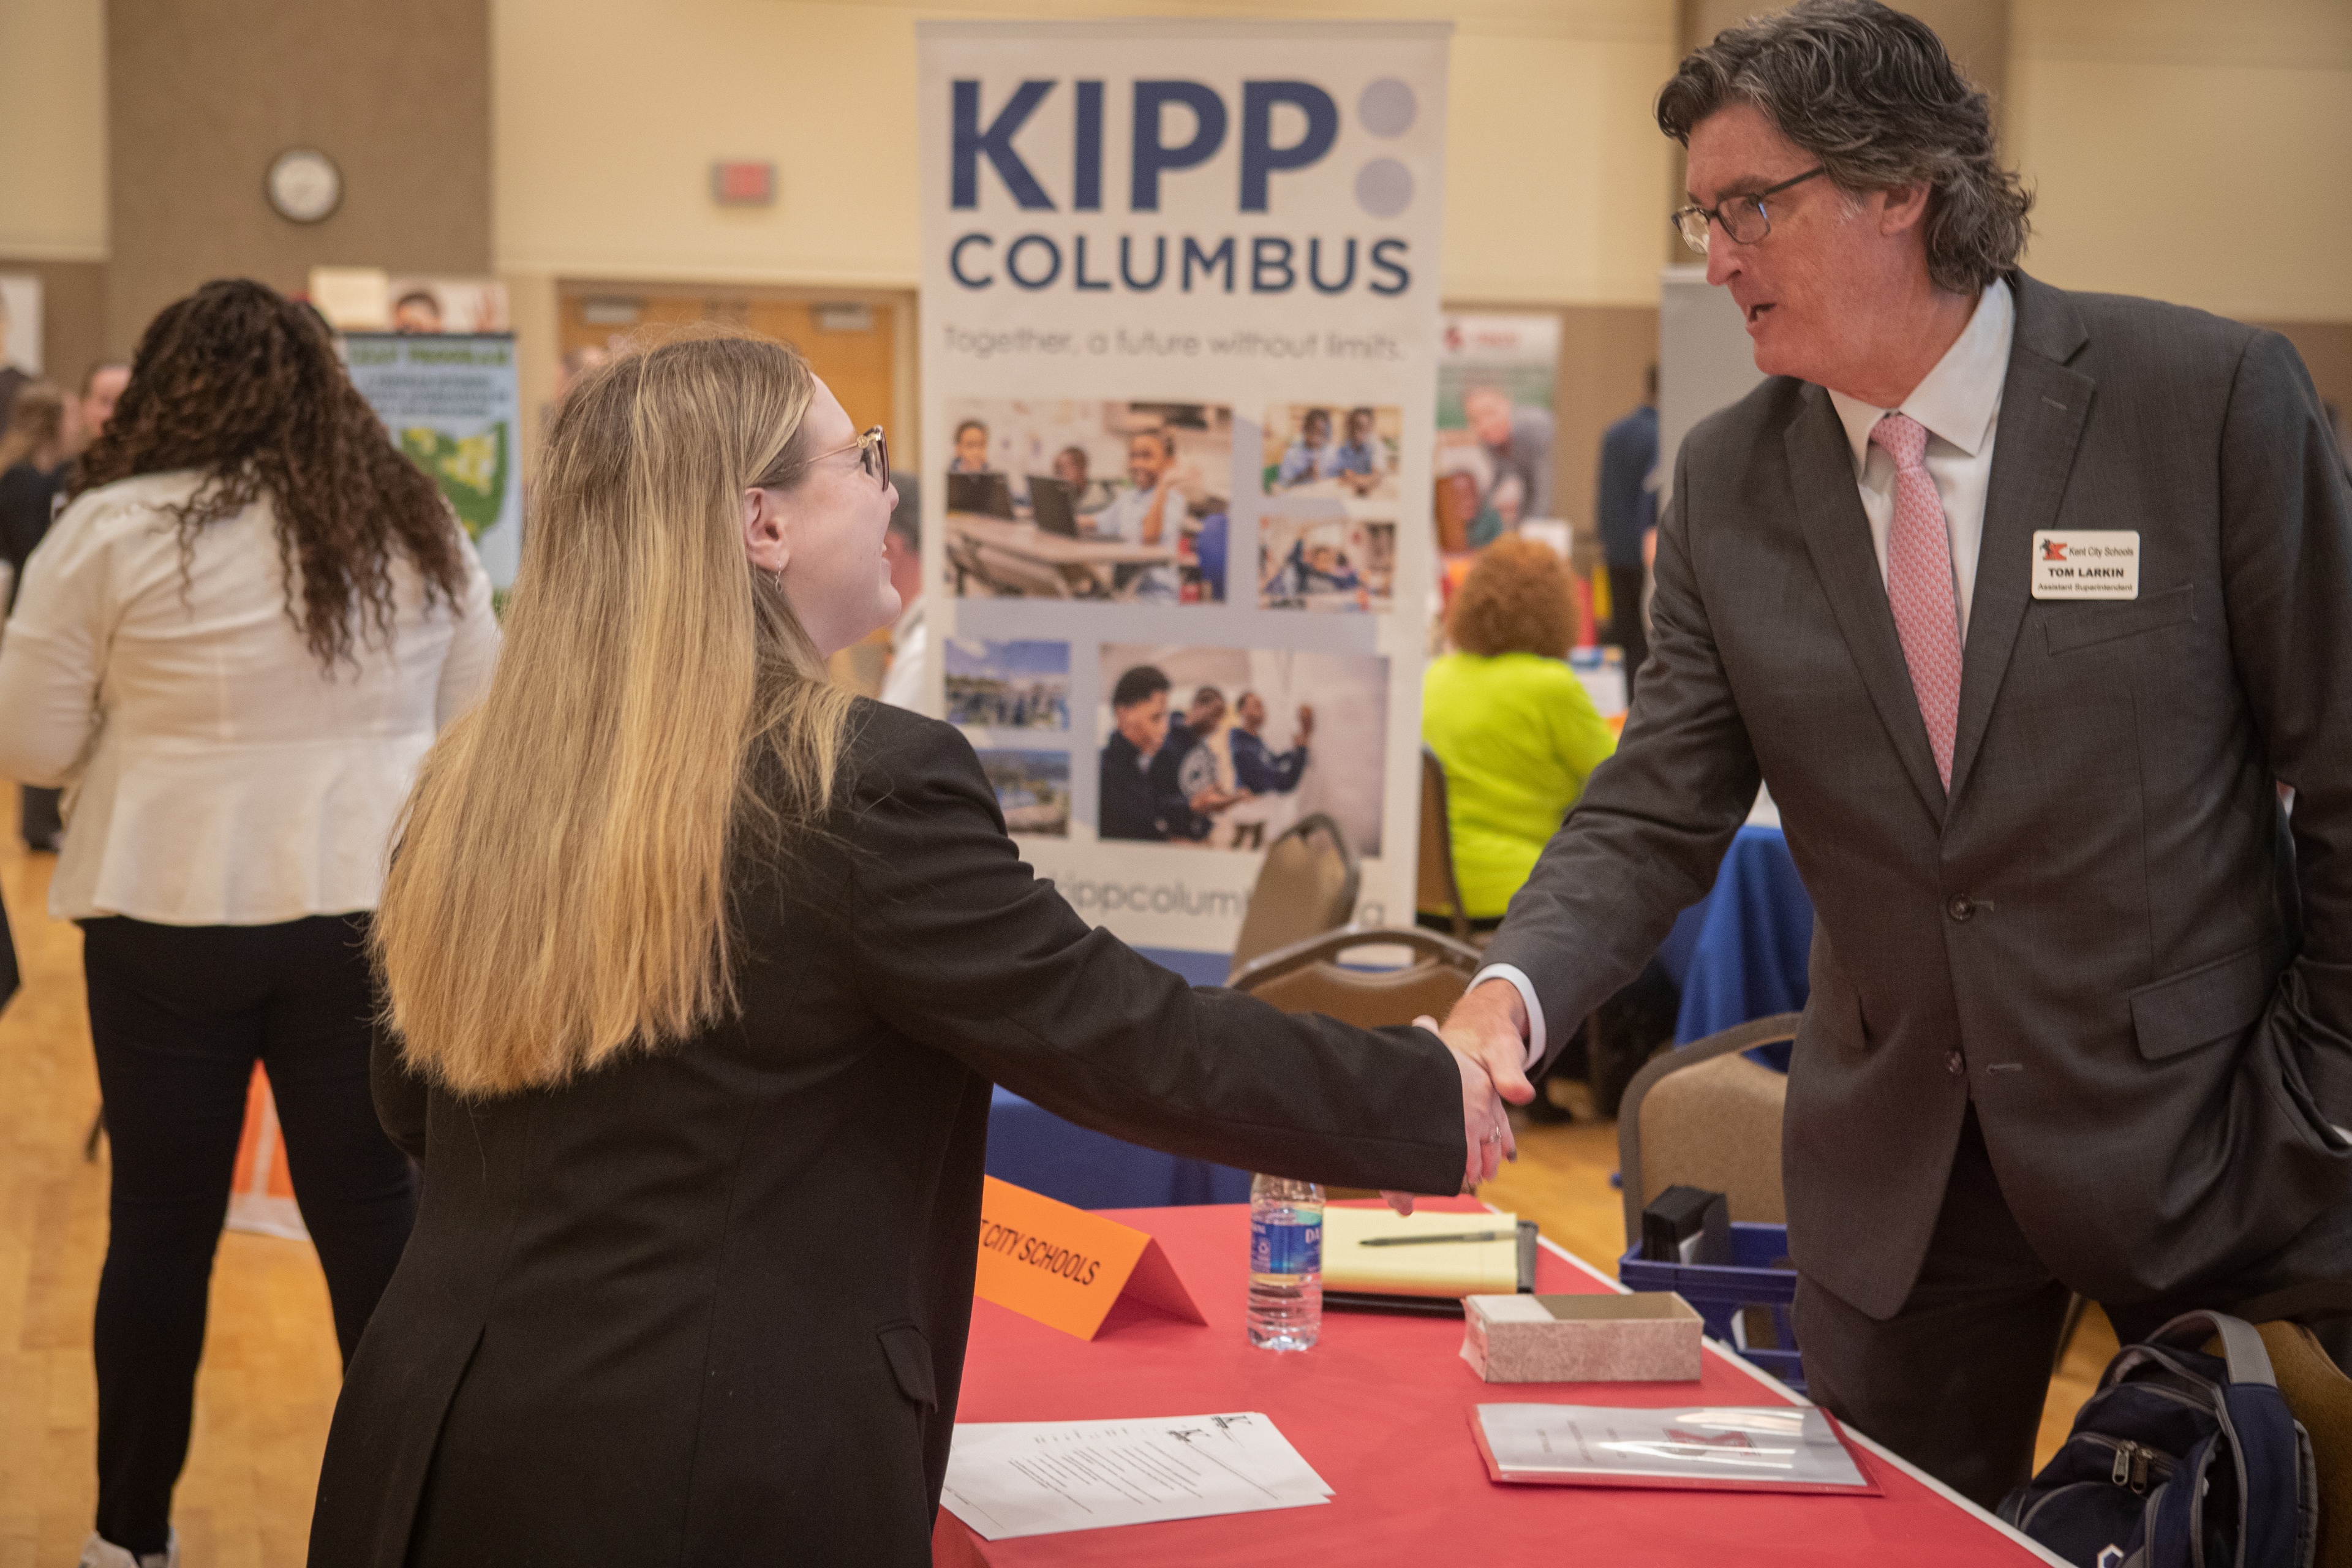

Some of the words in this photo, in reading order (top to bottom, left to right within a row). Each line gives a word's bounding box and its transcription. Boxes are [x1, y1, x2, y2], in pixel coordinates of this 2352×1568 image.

[949, 233, 1412, 296] COLUMBUS
[943, 322, 1082, 360] Together,
[1086, 332, 1110, 356] a
[1116, 327, 1202, 358] future
[1208, 331, 1319, 359] without
[1325, 332, 1408, 361] limits.
[2069, 547, 2086, 557] Kent
[2087, 547, 2101, 559] City
[2104, 547, 2133, 557] Schools
[2048, 567, 2075, 578] TOM
[2078, 567, 2124, 578] LARKIN
[2038, 583, 2072, 592] Assistant
[2075, 584, 2132, 594] Superintendent
[983, 1223, 1025, 1256] CITY
[1017, 1237, 1101, 1286] SCHOOLS
